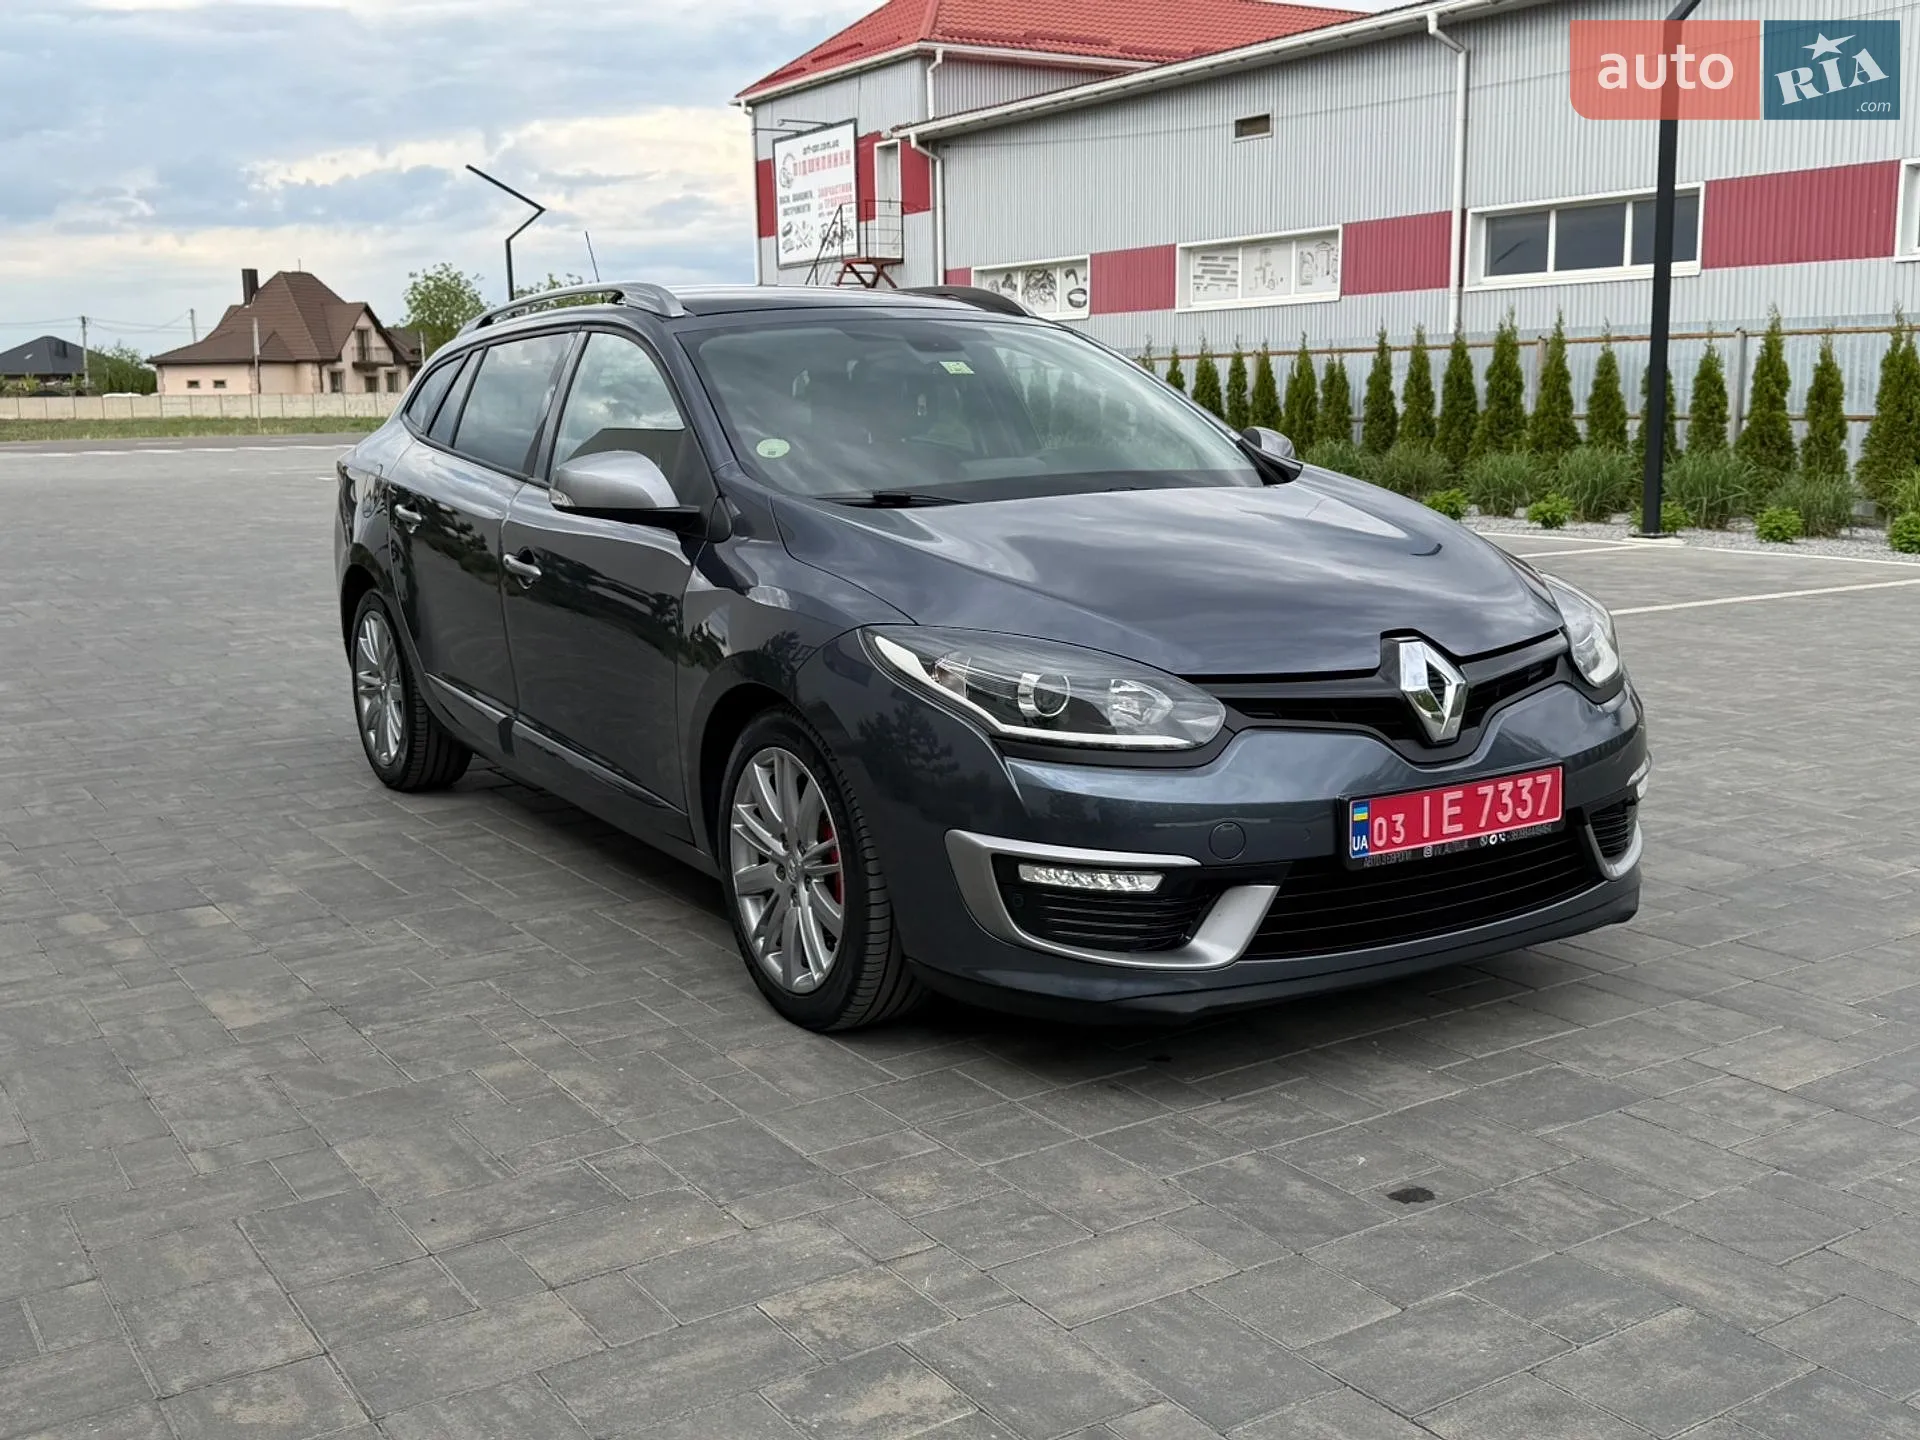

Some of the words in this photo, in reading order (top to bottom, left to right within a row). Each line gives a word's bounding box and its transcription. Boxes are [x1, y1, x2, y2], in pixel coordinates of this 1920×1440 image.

[1373, 813, 1406, 847] 03
[1422, 790, 1464, 838] IE
[1477, 774, 1552, 828] 7337
[1352, 834, 1369, 851] UA
